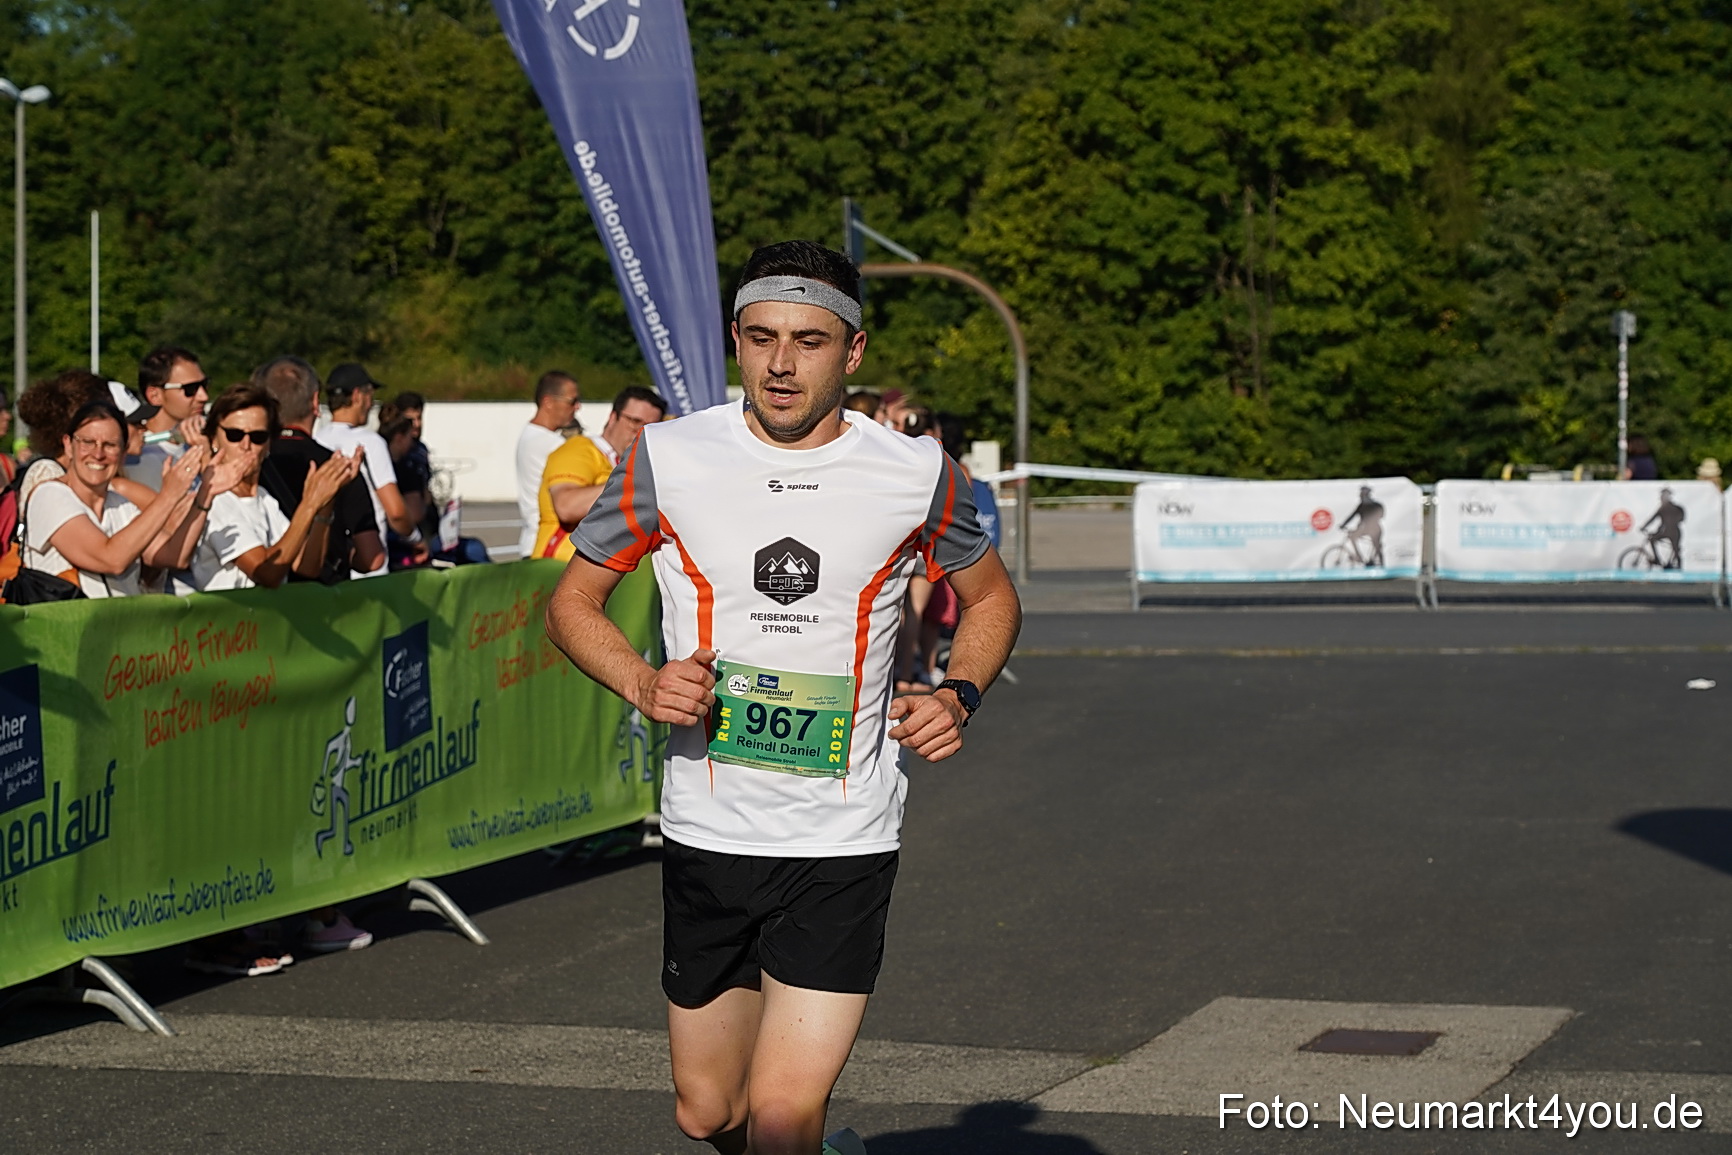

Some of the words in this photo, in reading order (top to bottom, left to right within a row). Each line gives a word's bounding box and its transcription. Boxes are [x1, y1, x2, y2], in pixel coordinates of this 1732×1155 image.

[786, 483, 819, 491] spized
[750, 613, 820, 623] REISEMOBILE
[761, 624, 803, 634] STROBL
[104, 626, 193, 700] Gesunde
[196, 620, 258, 668] Firmen
[144, 688, 203, 749] laufen
[208, 655, 277, 730] länger!
[750, 686, 794, 698] Firmenlauf
[717, 707, 733, 742] RUN
[745, 702, 819, 742] 967
[828, 717, 845, 763] 2022
[360, 699, 481, 817] firmenlauf
[736, 735, 777, 754] Reindl
[780, 743, 821, 758] Daniel
[62, 857, 275, 943] www.firmenlauf-oberpfalz.de
